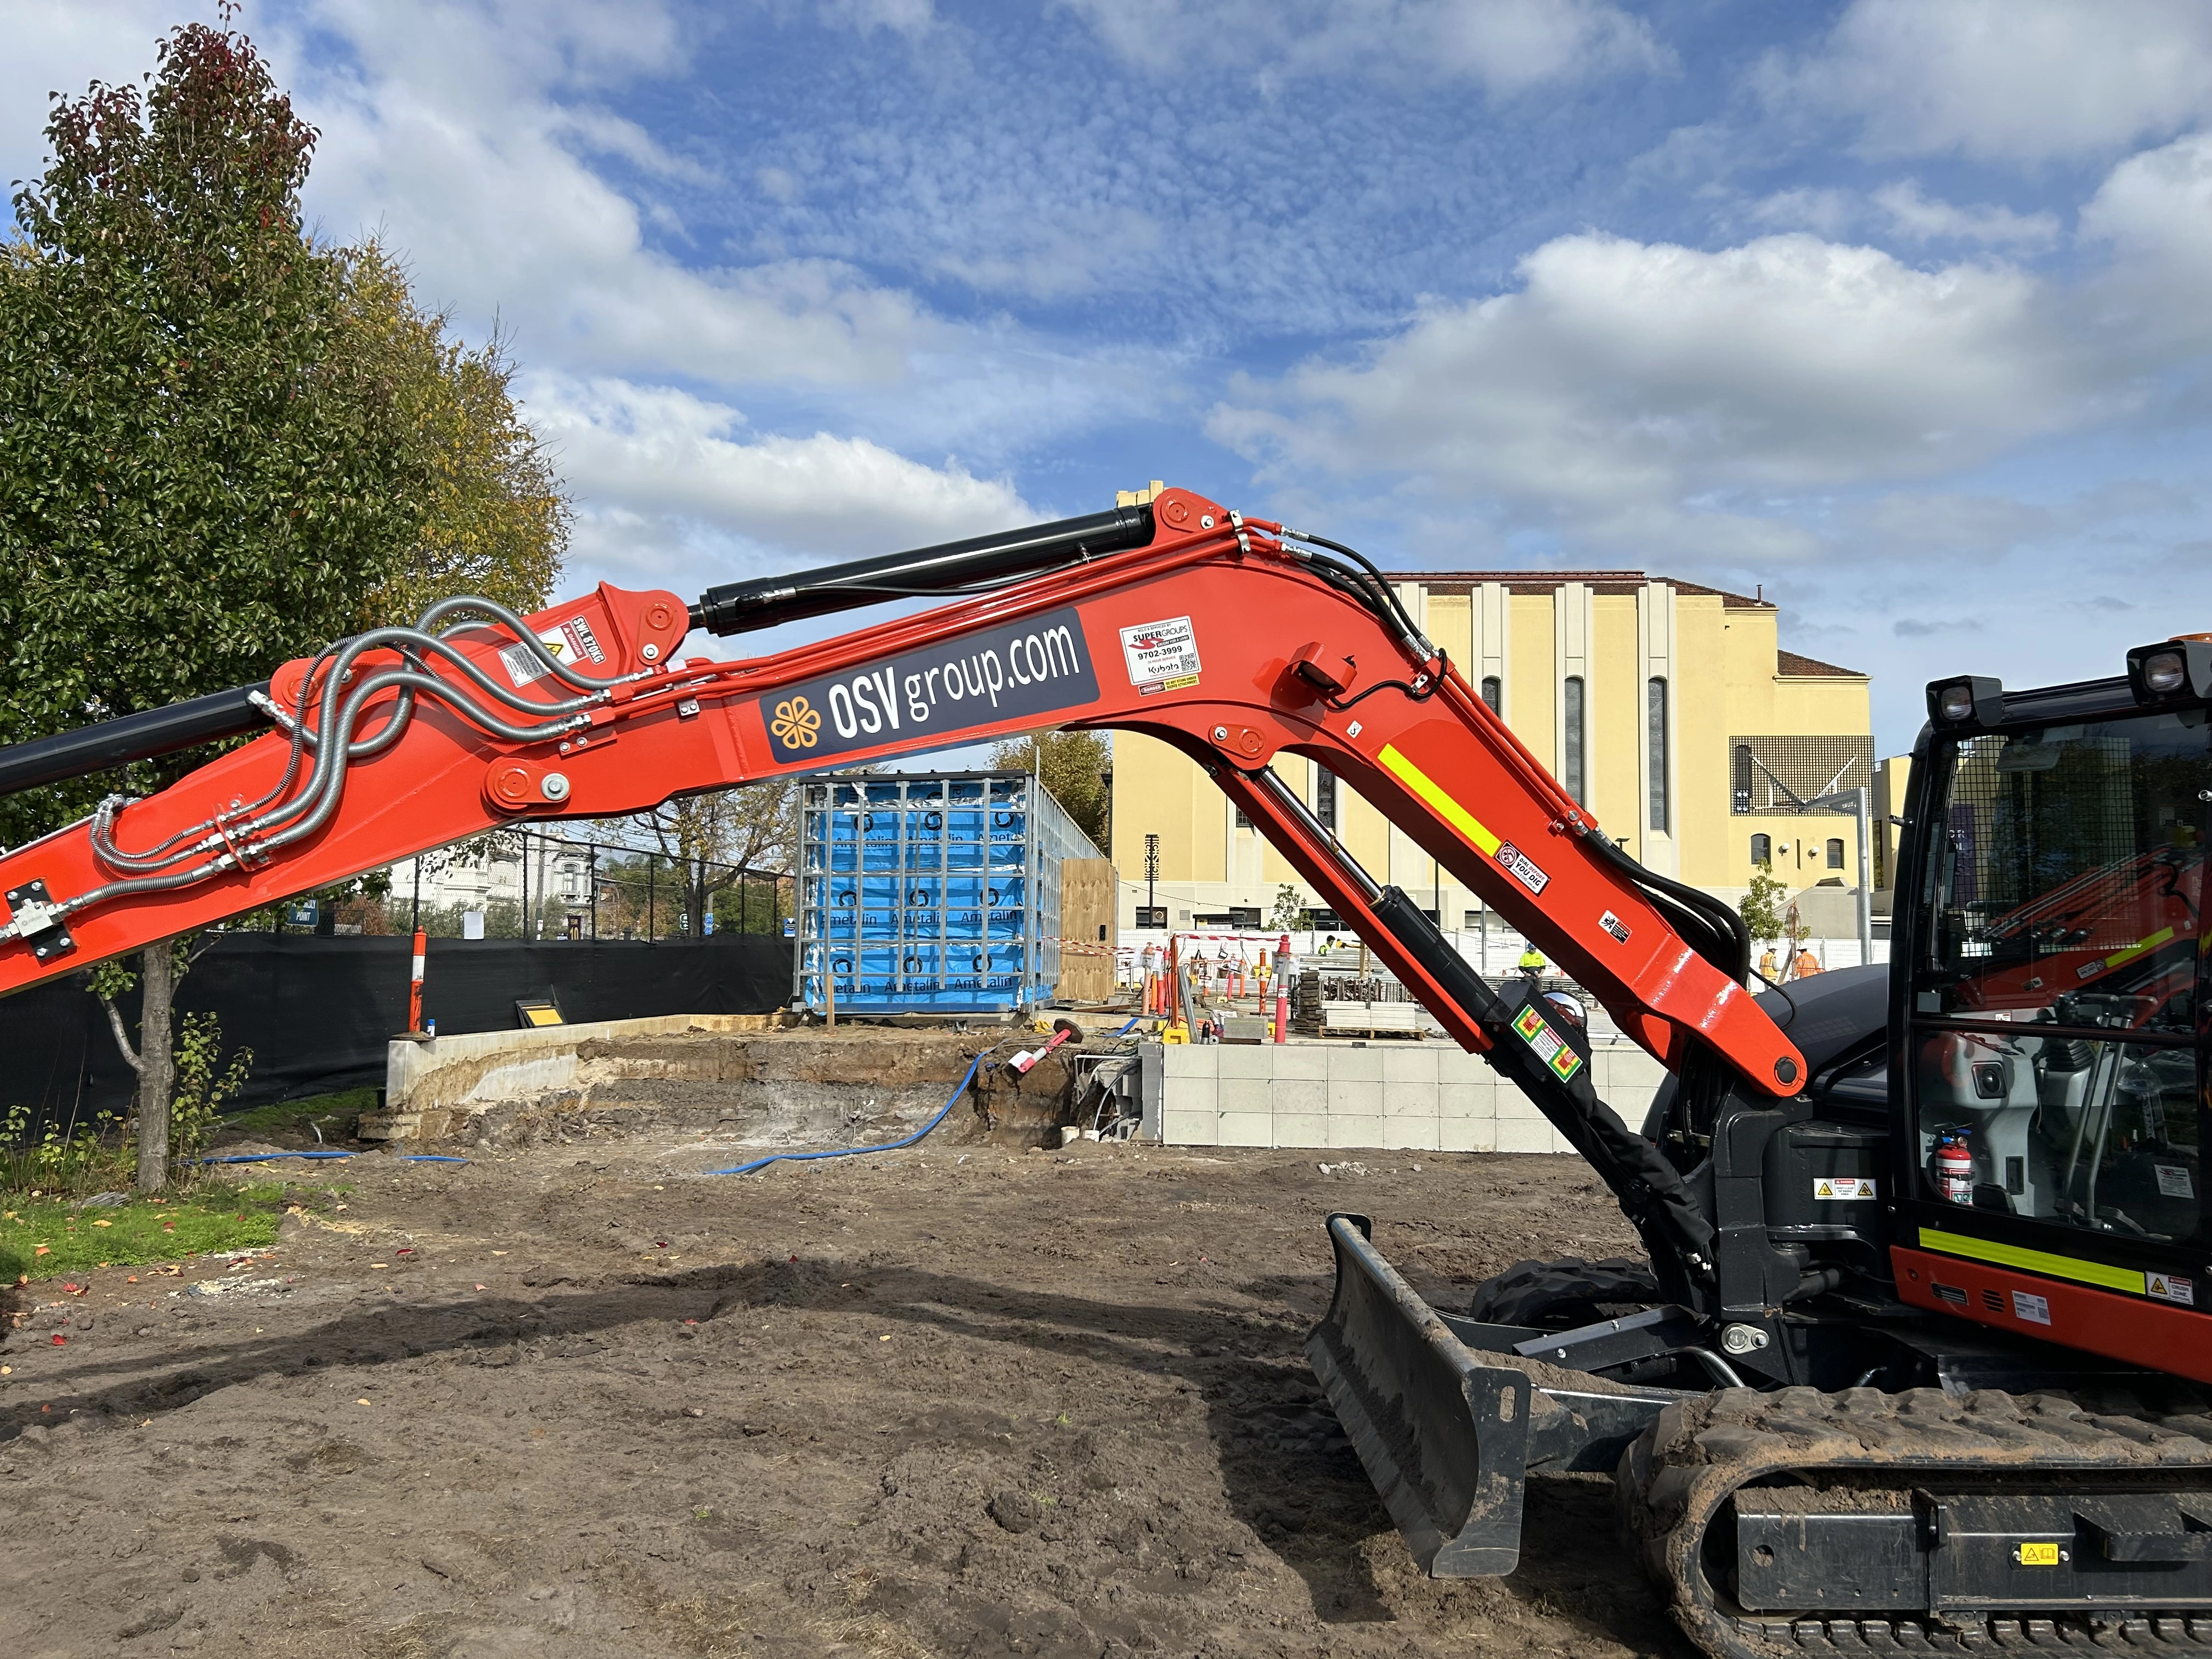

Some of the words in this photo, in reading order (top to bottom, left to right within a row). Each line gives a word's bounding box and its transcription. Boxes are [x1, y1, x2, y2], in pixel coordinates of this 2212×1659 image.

[573, 617, 589, 637] SWL
[583, 636, 605, 663] 870KG
[1133, 625, 1188, 642] SUPERGROUPS
[567, 634, 583, 656] DANGER
[1138, 646, 1182, 659] 9702-3999
[1148, 663, 1179, 674] Kubota
[1515, 861, 1530, 876] YOU
[1528, 873, 1542, 886] DIG
[1519, 857, 1530, 867] DIAL
[1528, 865, 1545, 881] BEFORE
[296, 912, 311, 921] POINT
[820, 913, 877, 925] Ametlin
[961, 910, 1017, 922] Amtalin
